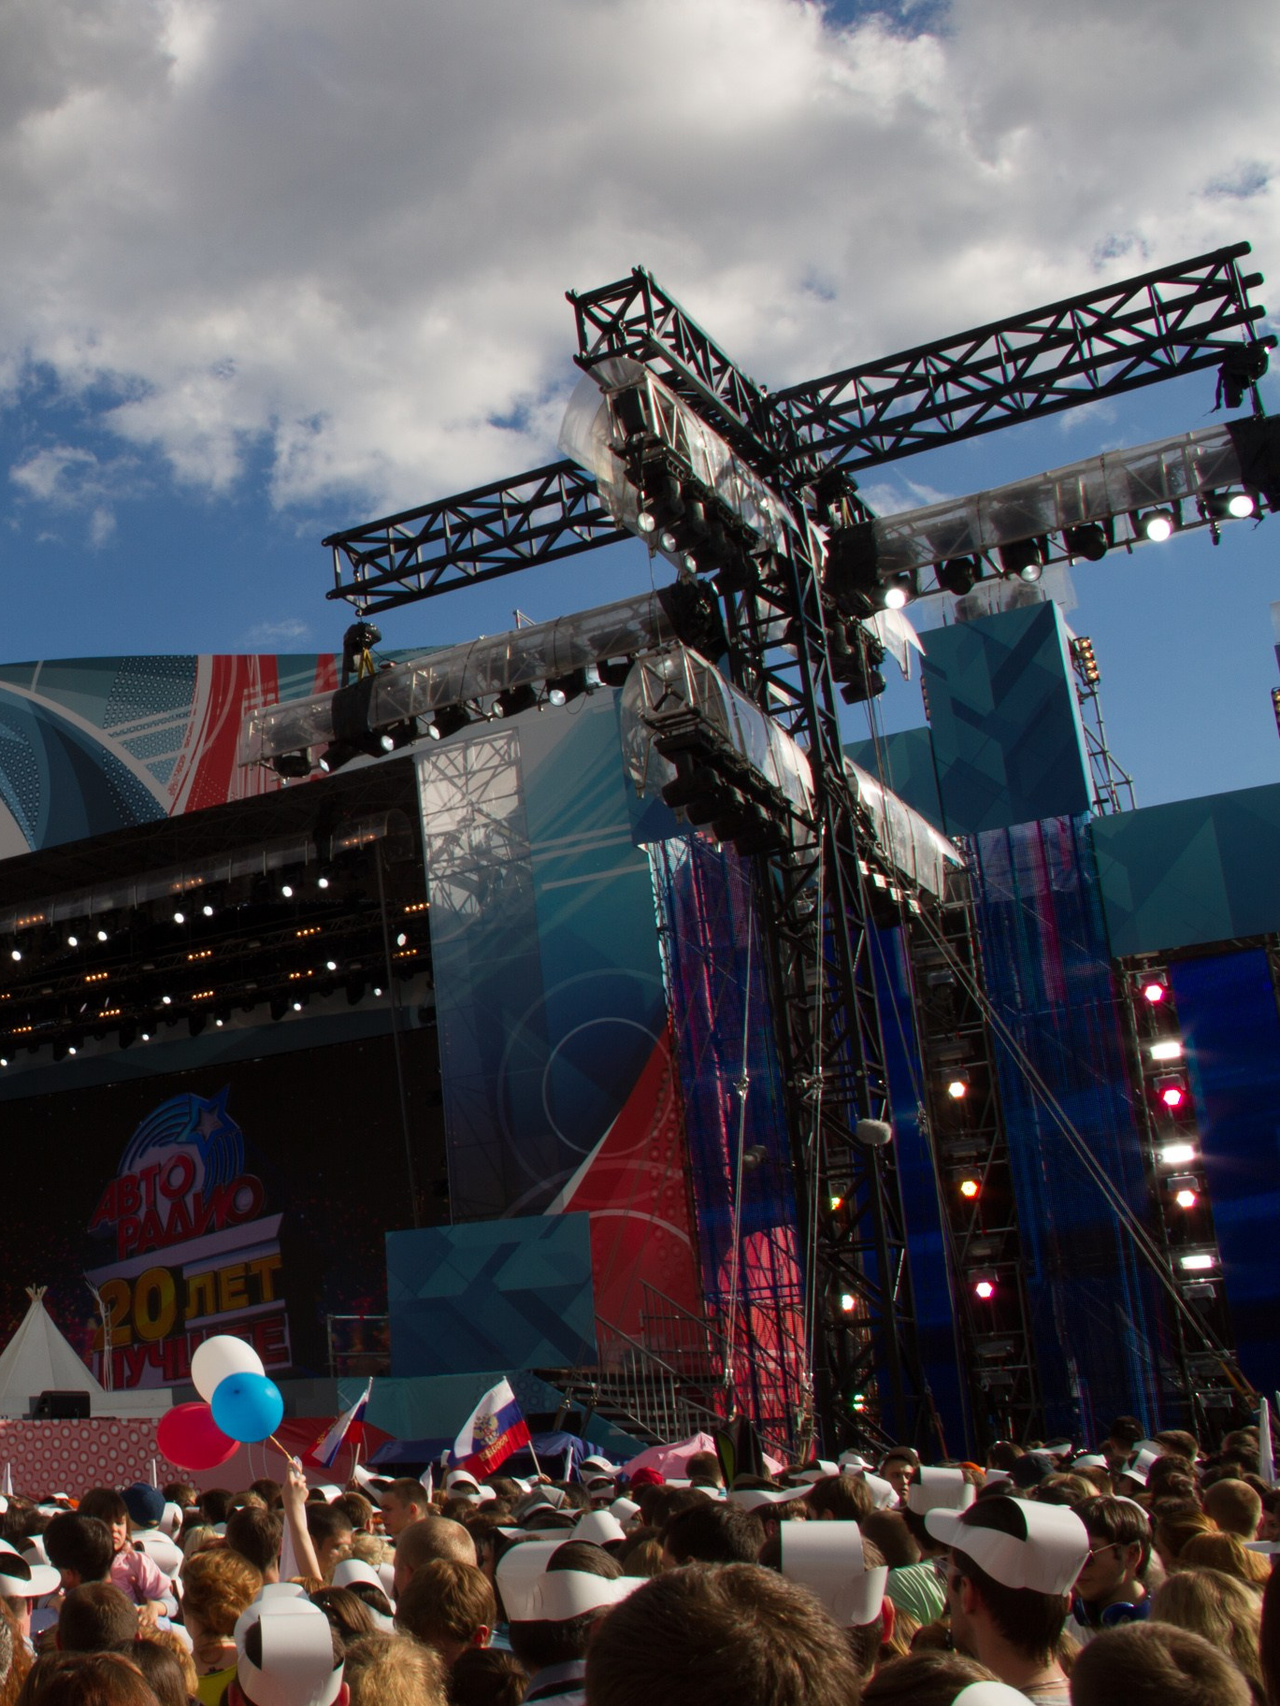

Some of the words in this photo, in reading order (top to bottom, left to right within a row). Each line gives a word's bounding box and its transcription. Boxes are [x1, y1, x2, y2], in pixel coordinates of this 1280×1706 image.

[88, 1153, 196, 1231] АВТО
[116, 1173, 265, 1261] РАДИО
[93, 1266, 177, 1350] 20
[184, 1253, 283, 1320] ЛЕТ
